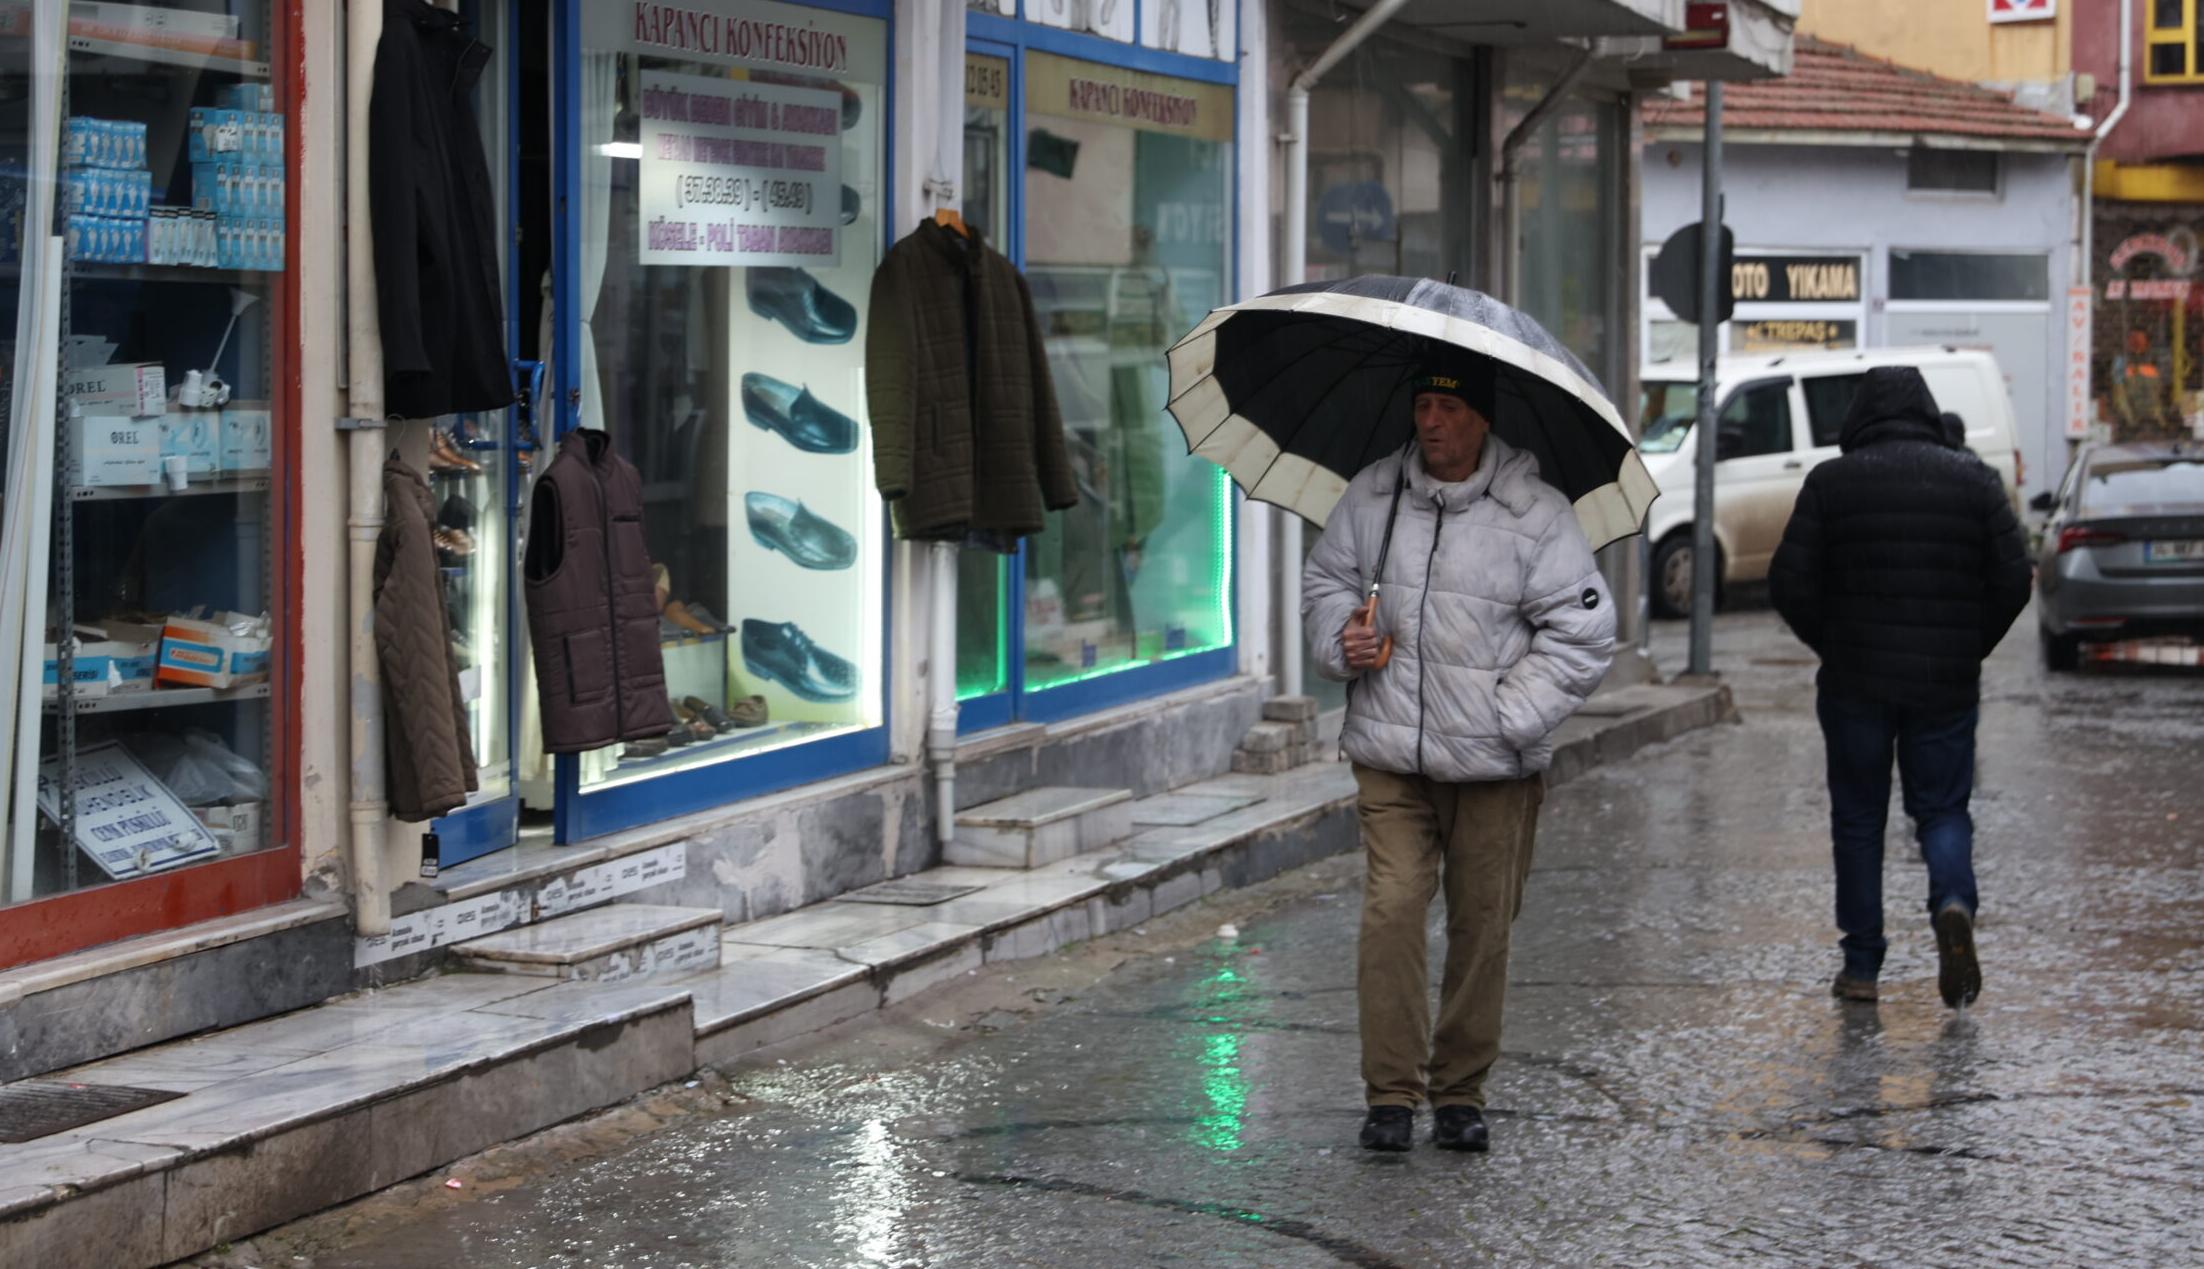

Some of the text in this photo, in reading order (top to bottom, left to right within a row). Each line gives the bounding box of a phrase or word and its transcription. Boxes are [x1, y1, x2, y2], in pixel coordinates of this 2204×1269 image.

[635, 2, 848, 72] KAPANCI KONFEKSİYON
[1732, 263, 1858, 298] OTO YIKAMA
